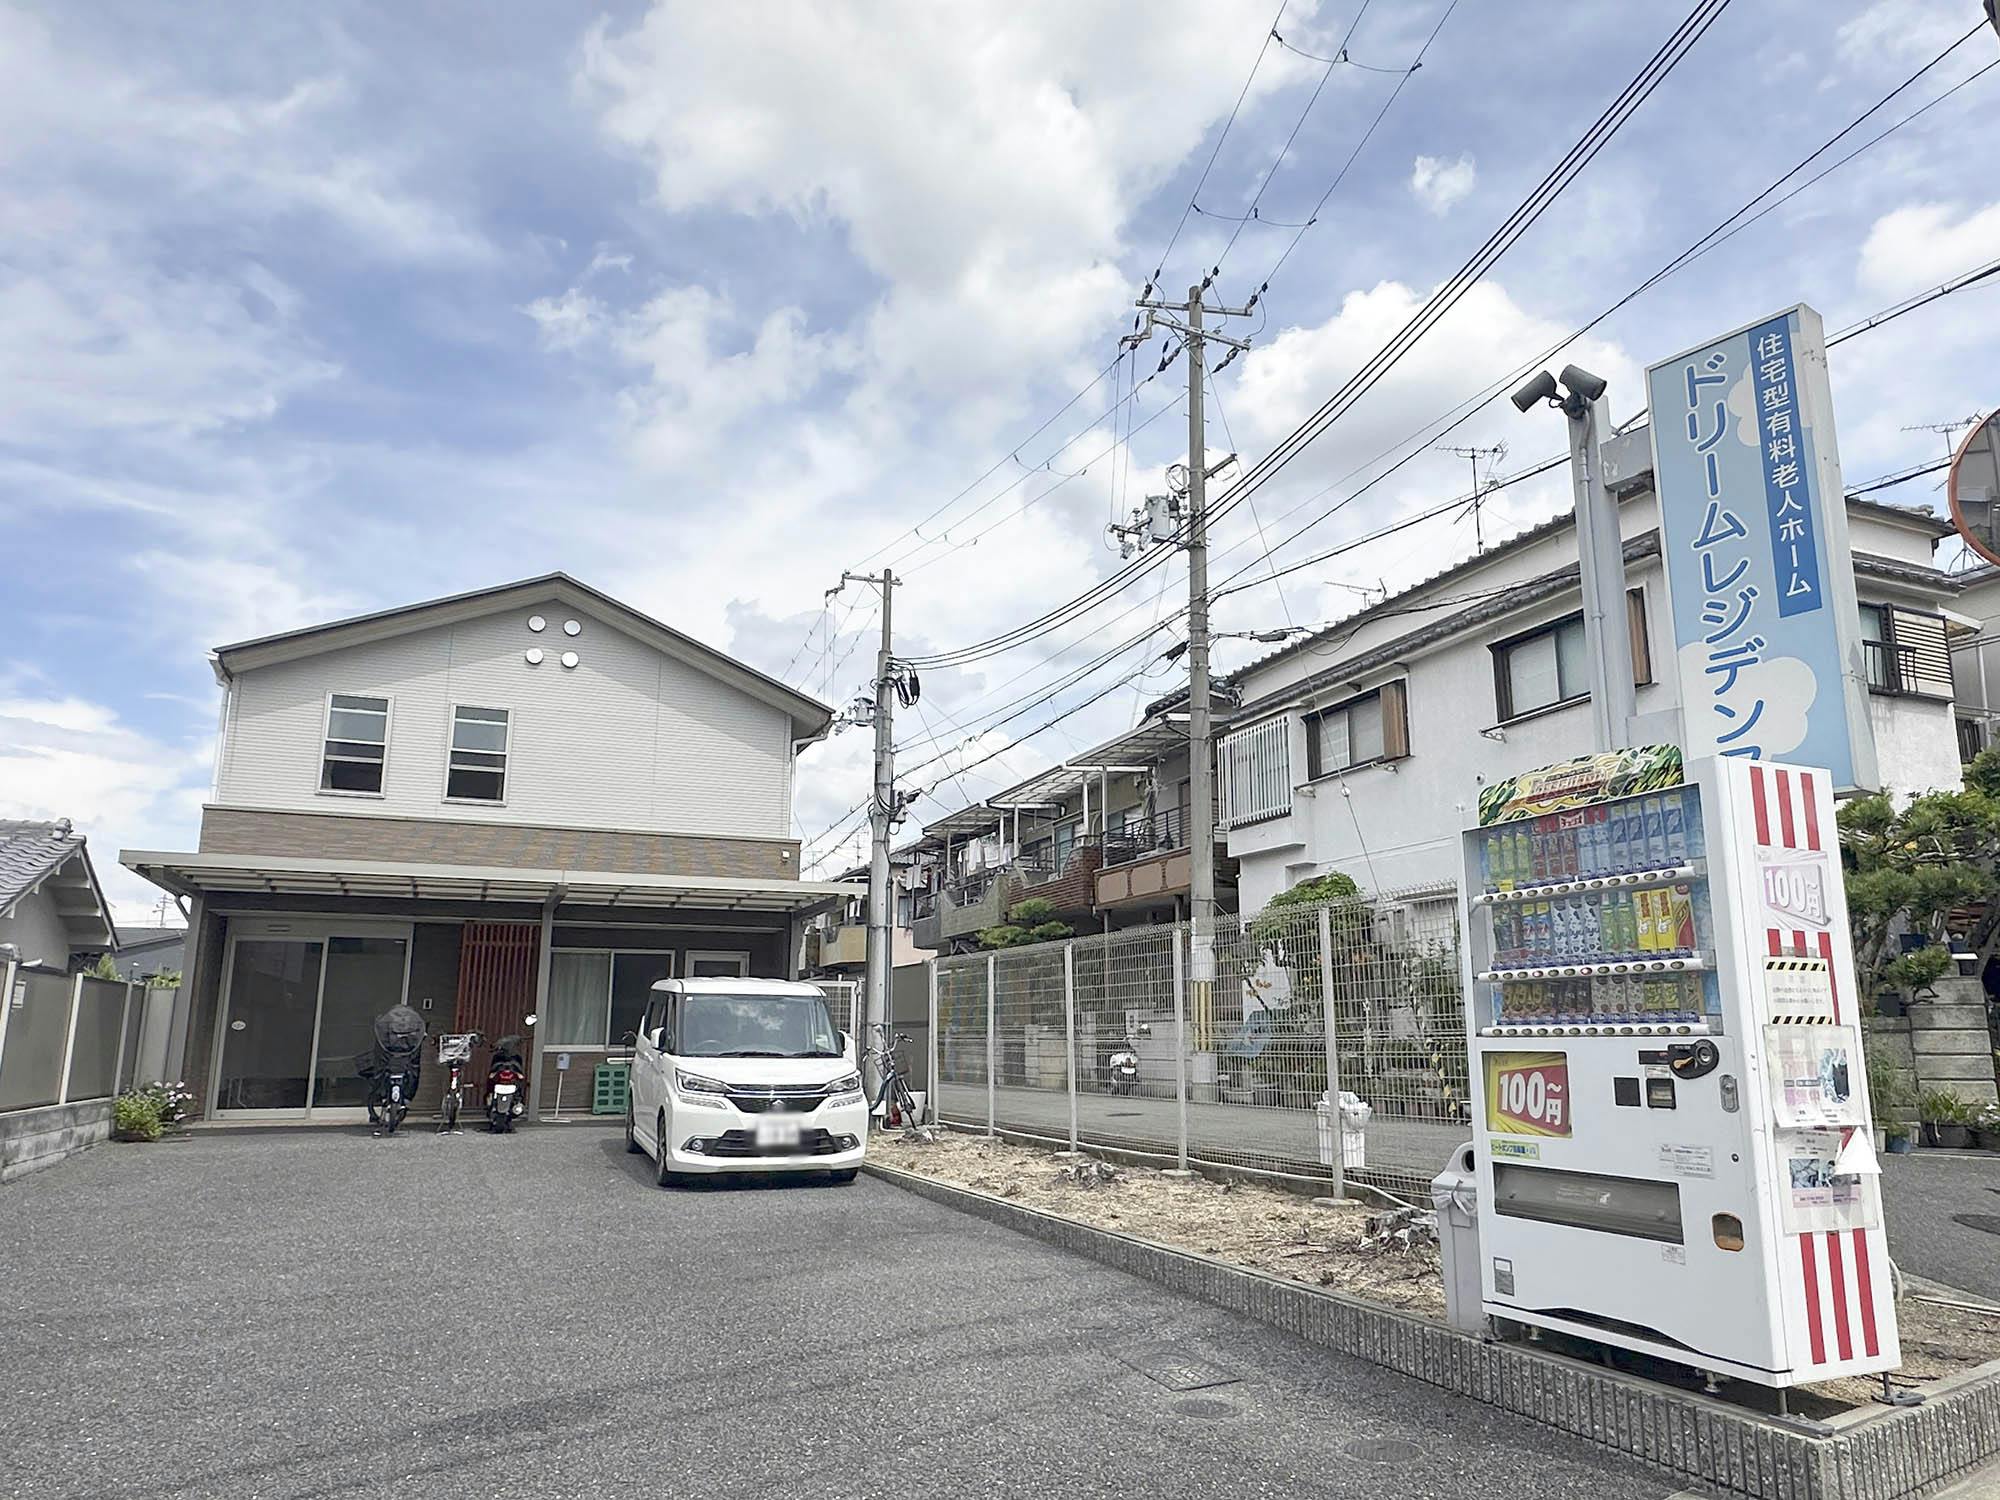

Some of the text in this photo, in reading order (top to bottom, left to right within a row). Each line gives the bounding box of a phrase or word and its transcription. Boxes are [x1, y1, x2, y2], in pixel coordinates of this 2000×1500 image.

[1757, 332, 1812, 598] 住宅型有料老人ホーム
